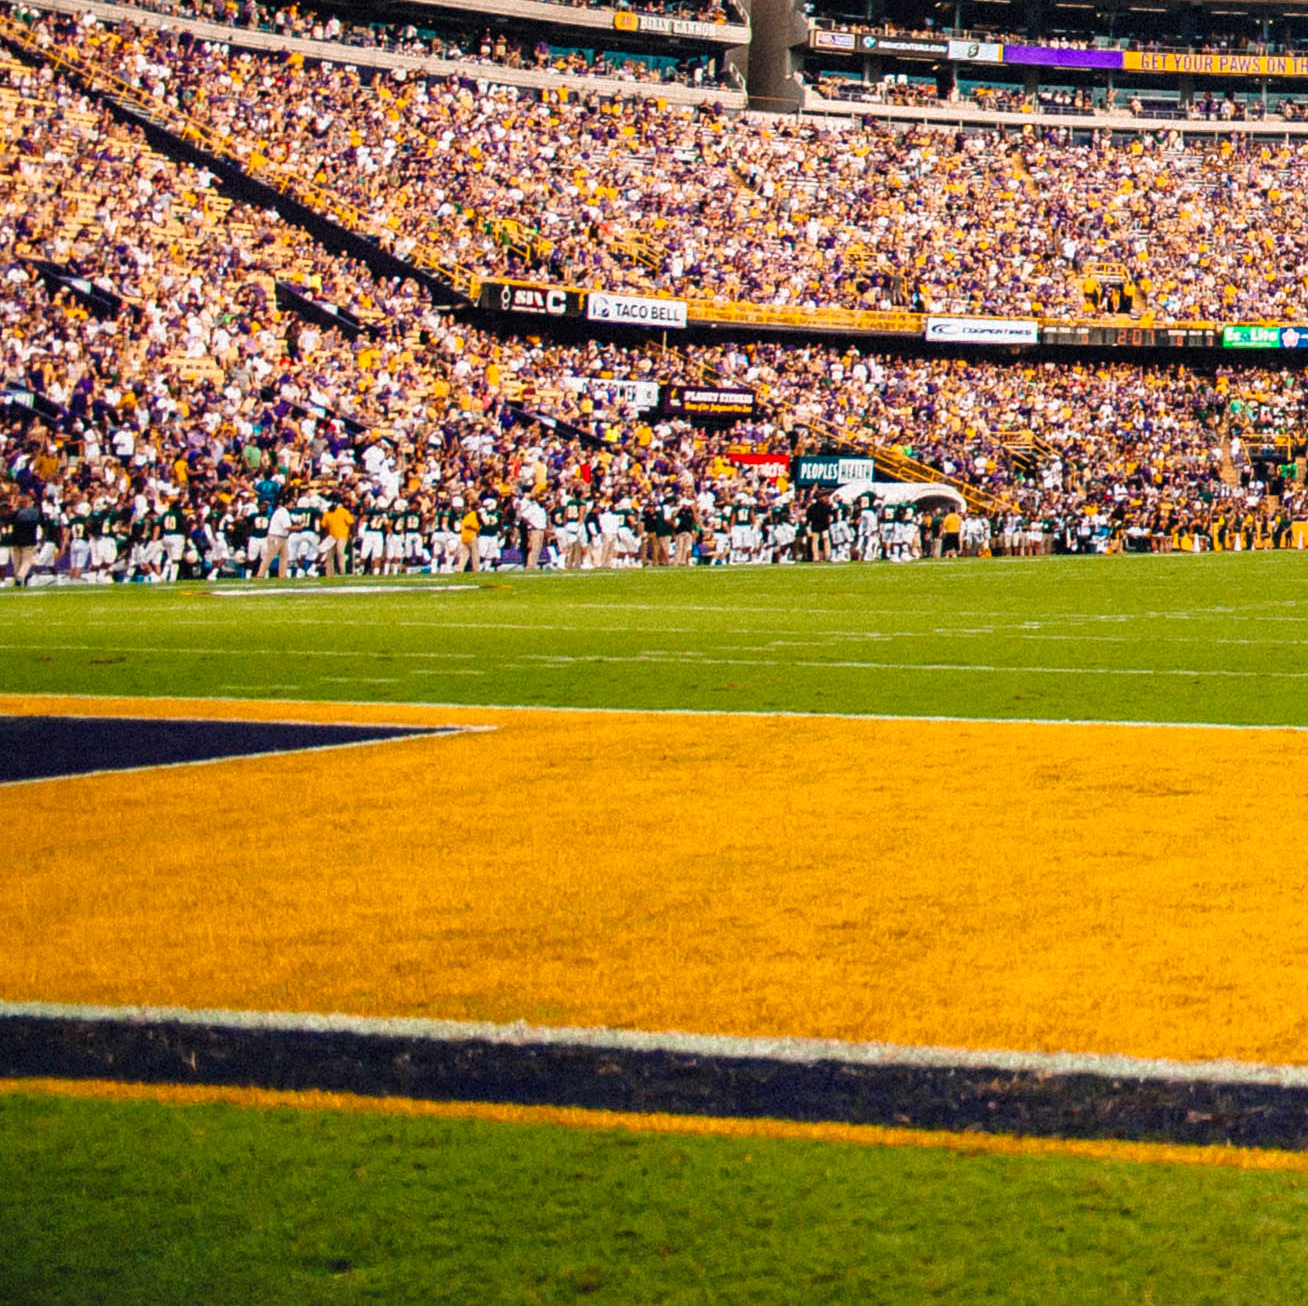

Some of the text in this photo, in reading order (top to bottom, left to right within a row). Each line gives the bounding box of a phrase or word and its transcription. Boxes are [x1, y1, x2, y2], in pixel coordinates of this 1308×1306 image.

[1141, 54, 1168, 69] GET
[1174, 54, 1213, 70] YOUR
[1220, 55, 1260, 72] PAWS
[1267, 56, 1287, 72] ON
[616, 303, 681, 322] TACO BELL
[800, 463, 838, 479] PEOPLES
[841, 464, 872, 479] HEALTH
